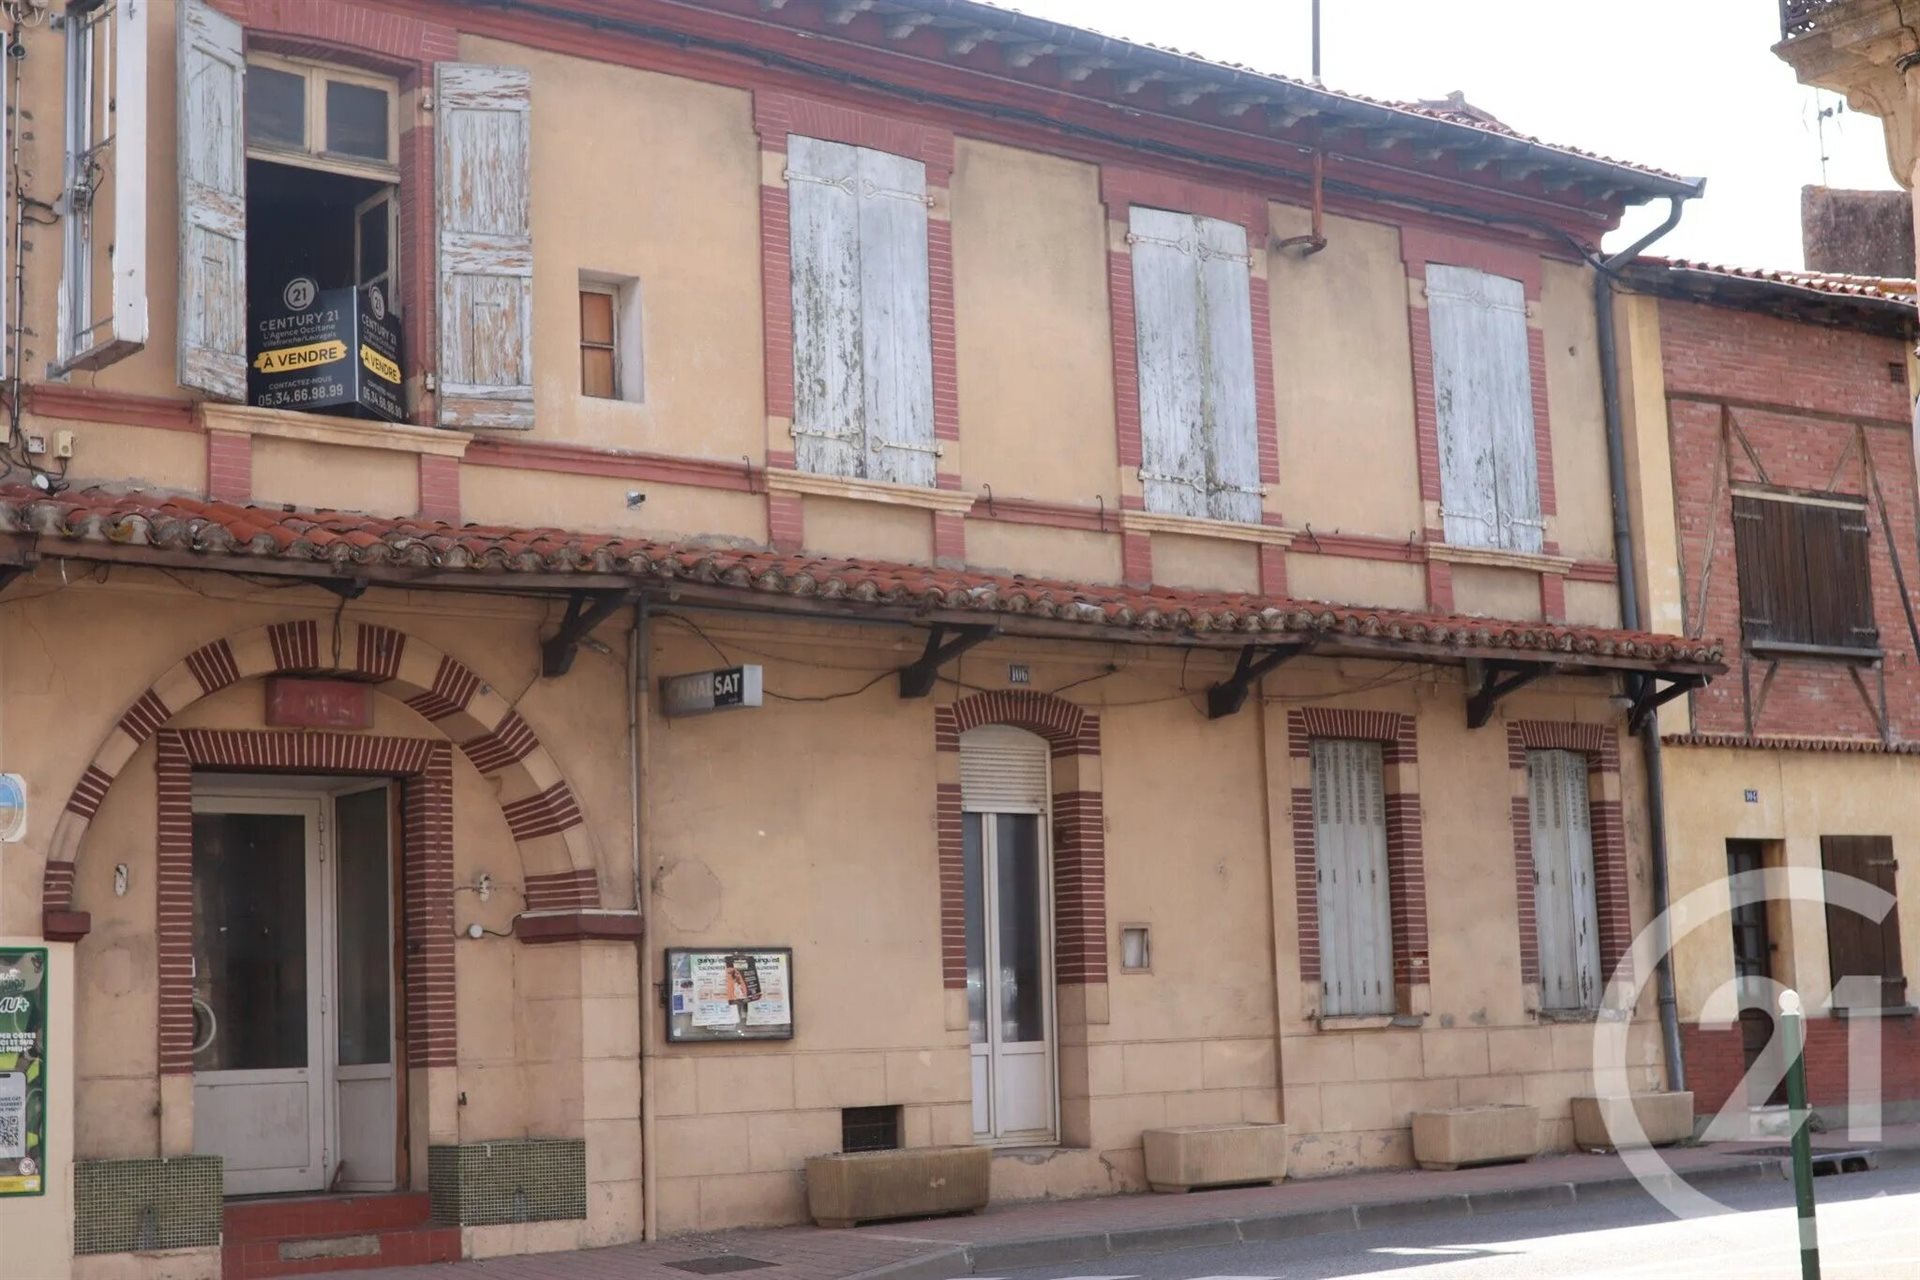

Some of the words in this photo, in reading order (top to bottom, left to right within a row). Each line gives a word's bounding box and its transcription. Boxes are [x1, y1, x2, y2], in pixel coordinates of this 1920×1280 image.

[292, 287, 307, 302] 21
[259, 312, 324, 331] CENTURY
[326, 309, 339, 322] 21
[299, 323, 336, 335] Occitane
[361, 313, 390, 340] CENTURY
[263, 353, 274, 369] À
[278, 347, 338, 366] VENDRE
[370, 354, 397, 382] VENDRE
